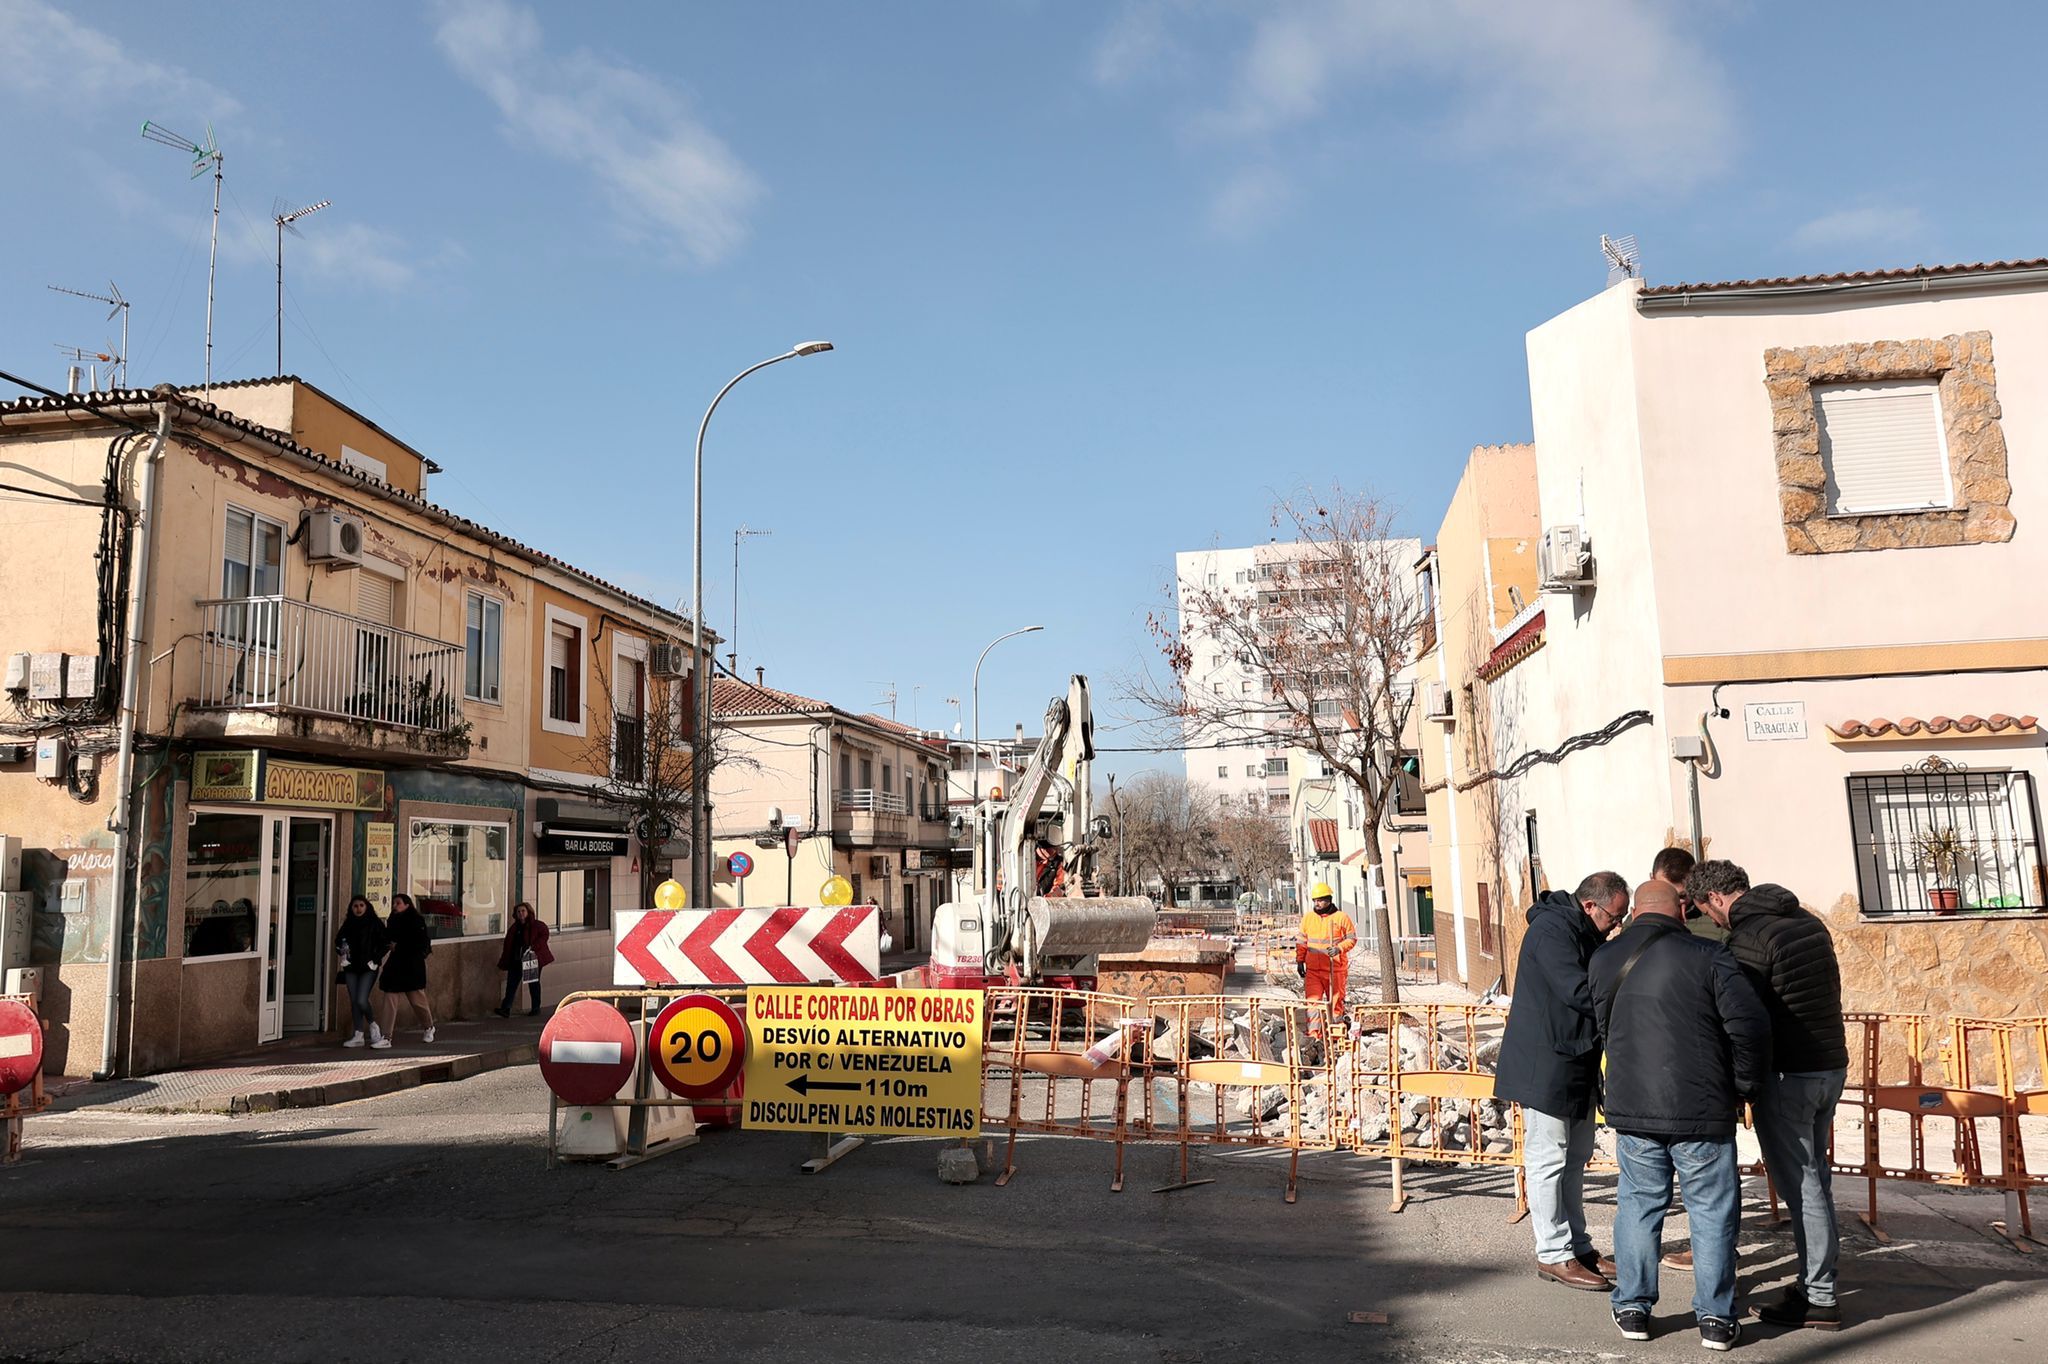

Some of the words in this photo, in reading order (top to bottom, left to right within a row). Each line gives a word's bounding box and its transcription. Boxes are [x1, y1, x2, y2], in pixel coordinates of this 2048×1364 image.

[1753, 721, 1799, 734] PARAGUAY
[193, 786, 253, 800] AMARANTA
[267, 767, 355, 804] AMARANTA
[564, 839, 578, 851] BAR
[579, 840, 588, 851] LA
[588, 840, 614, 852] BODEGA
[957, 955, 982, 963] TB230
[755, 994, 802, 1019] CALLE
[808, 995, 879, 1021] CORTADA
[884, 996, 916, 1021] POR
[922, 996, 975, 1024] OBRAS
[670, 1030, 721, 1064] 20
[763, 1025, 830, 1045] DESVÍO
[836, 1029, 966, 1048] ALTERNATIVO
[774, 1052, 811, 1069] POR
[817, 1053, 834, 1070] C/
[840, 1053, 952, 1073] VENEZUELA
[866, 1079, 928, 1097] 110m
[750, 1101, 839, 1125] DISCULPEN
[845, 1104, 875, 1126] LAS
[881, 1105, 974, 1130] MOLESTIAS
